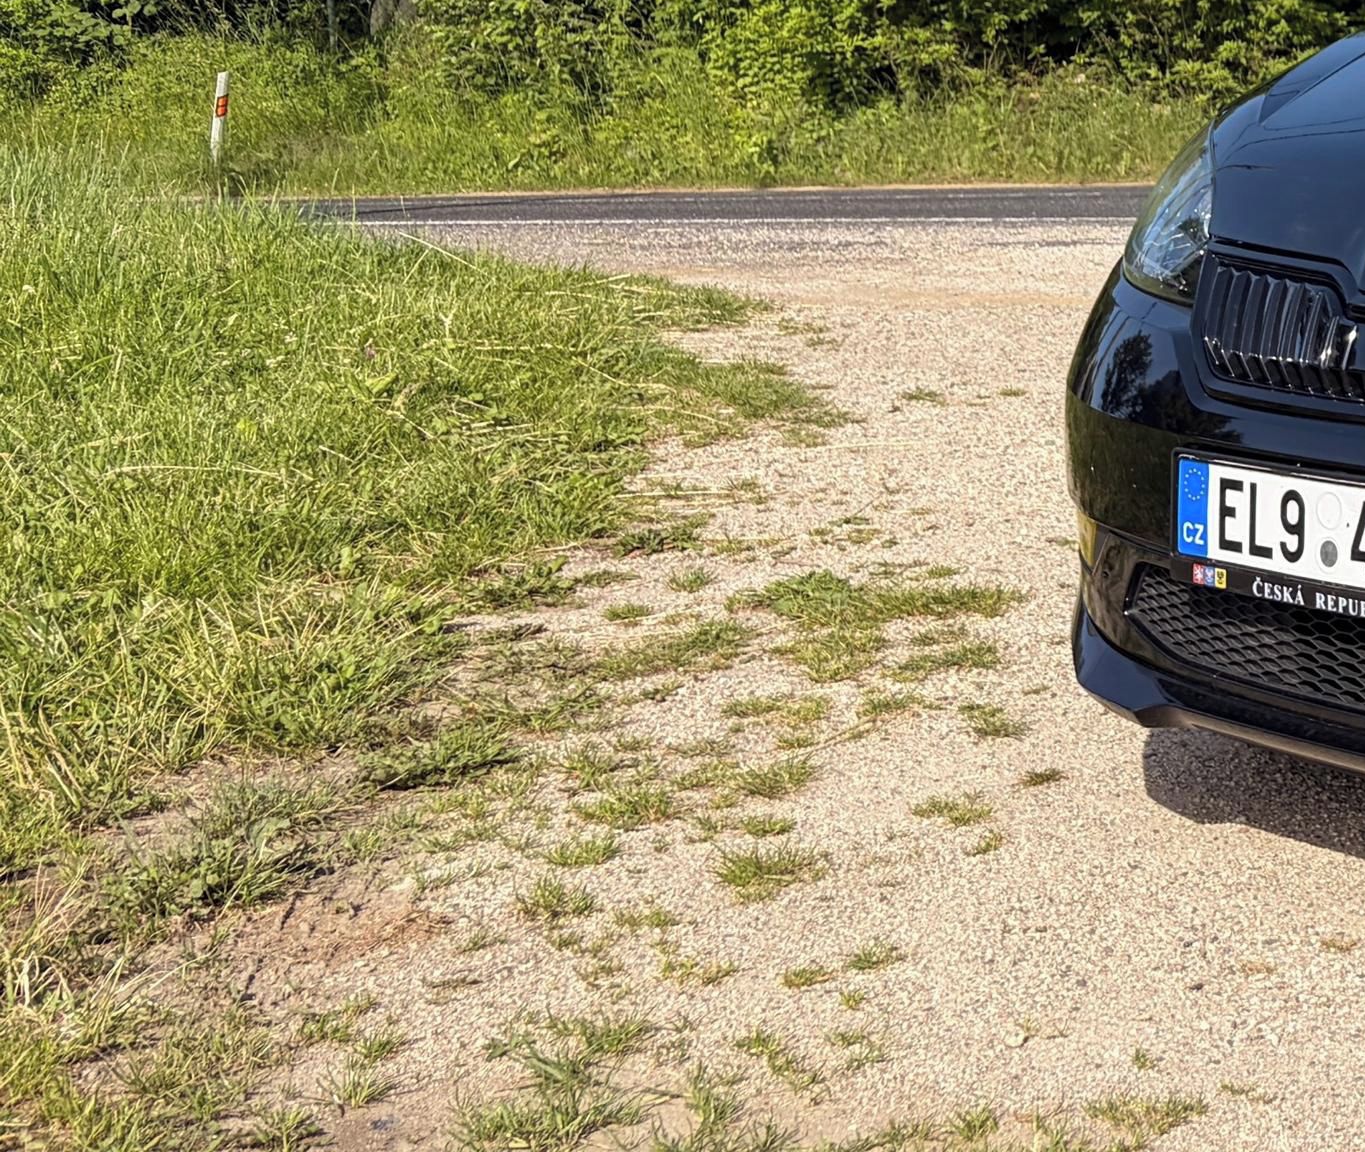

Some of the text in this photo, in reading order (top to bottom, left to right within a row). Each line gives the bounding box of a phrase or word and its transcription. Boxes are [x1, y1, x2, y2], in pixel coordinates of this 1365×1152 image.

[1183, 521, 1204, 545] CZ
[1218, 477, 1305, 563] EL9
[1252, 576, 1305, 606] ČESKÁ
